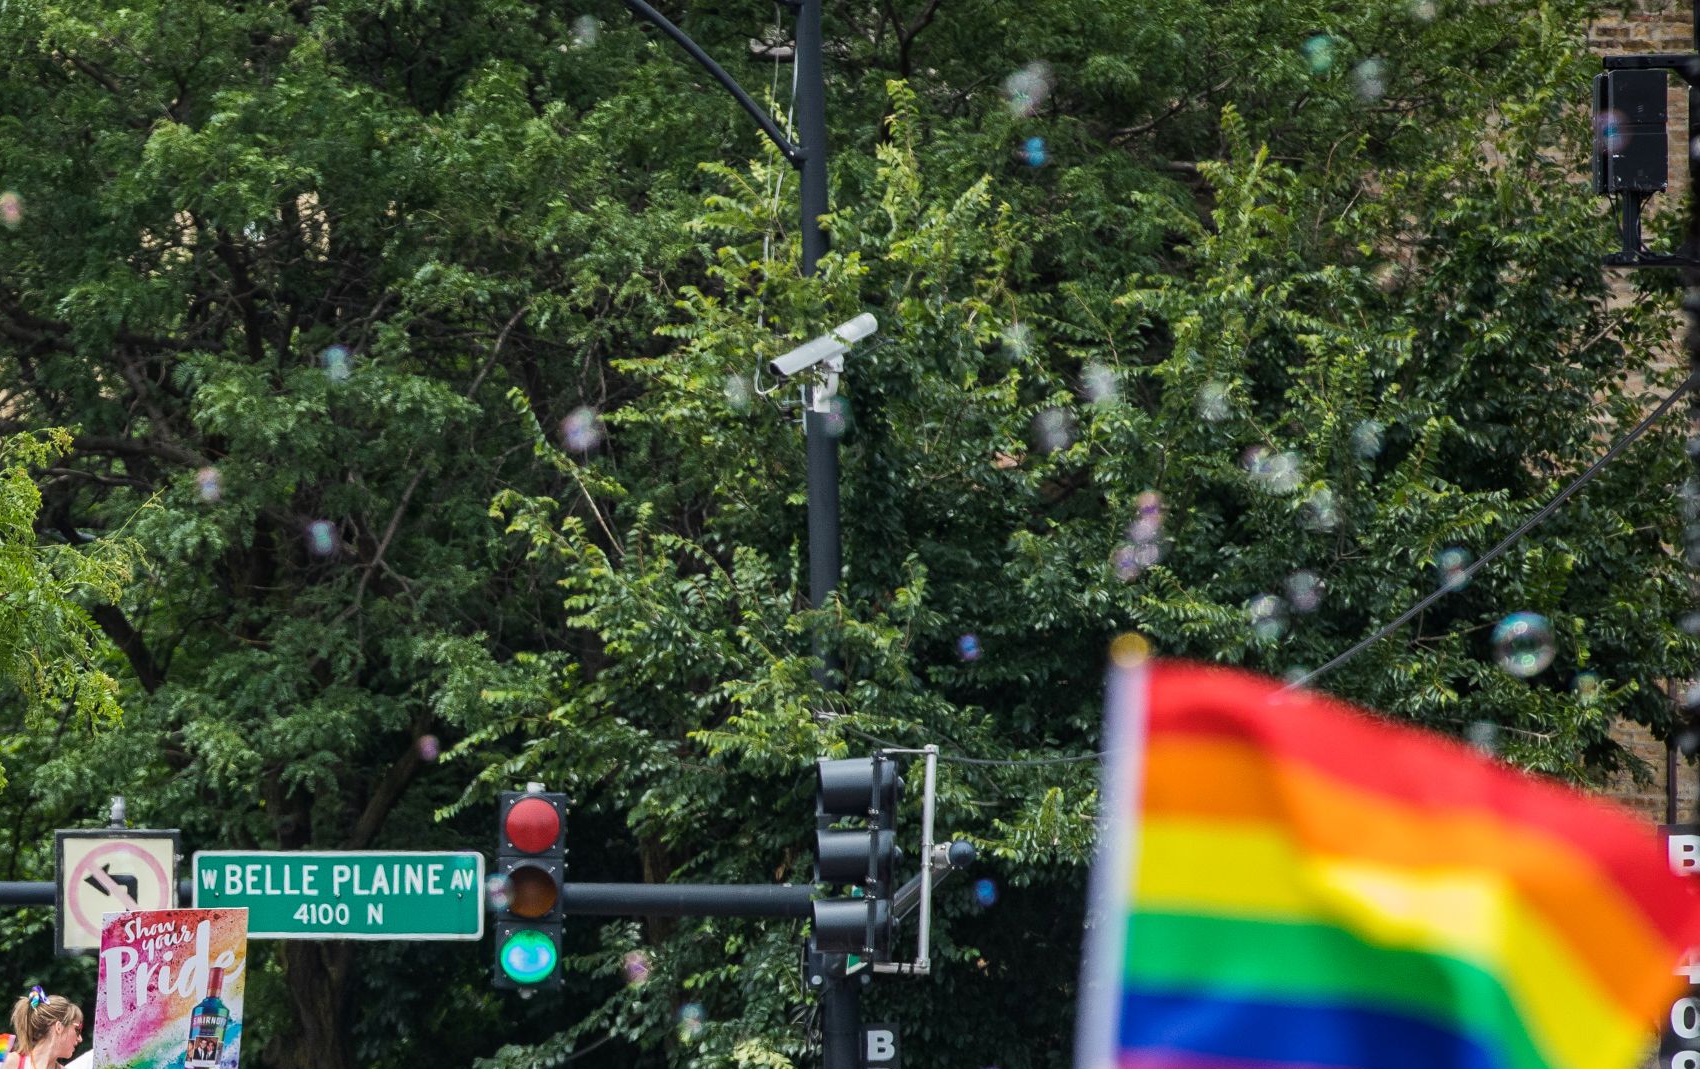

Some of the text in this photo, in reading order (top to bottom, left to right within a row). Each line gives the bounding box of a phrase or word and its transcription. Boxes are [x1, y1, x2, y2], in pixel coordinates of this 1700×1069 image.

[201, 863, 474, 896] W BELLE PLAINE AV
[124, 916, 176, 944] Show
[293, 903, 384, 925] 4100 N
[141, 924, 195, 961] your
[101, 919, 246, 1021] Pride
